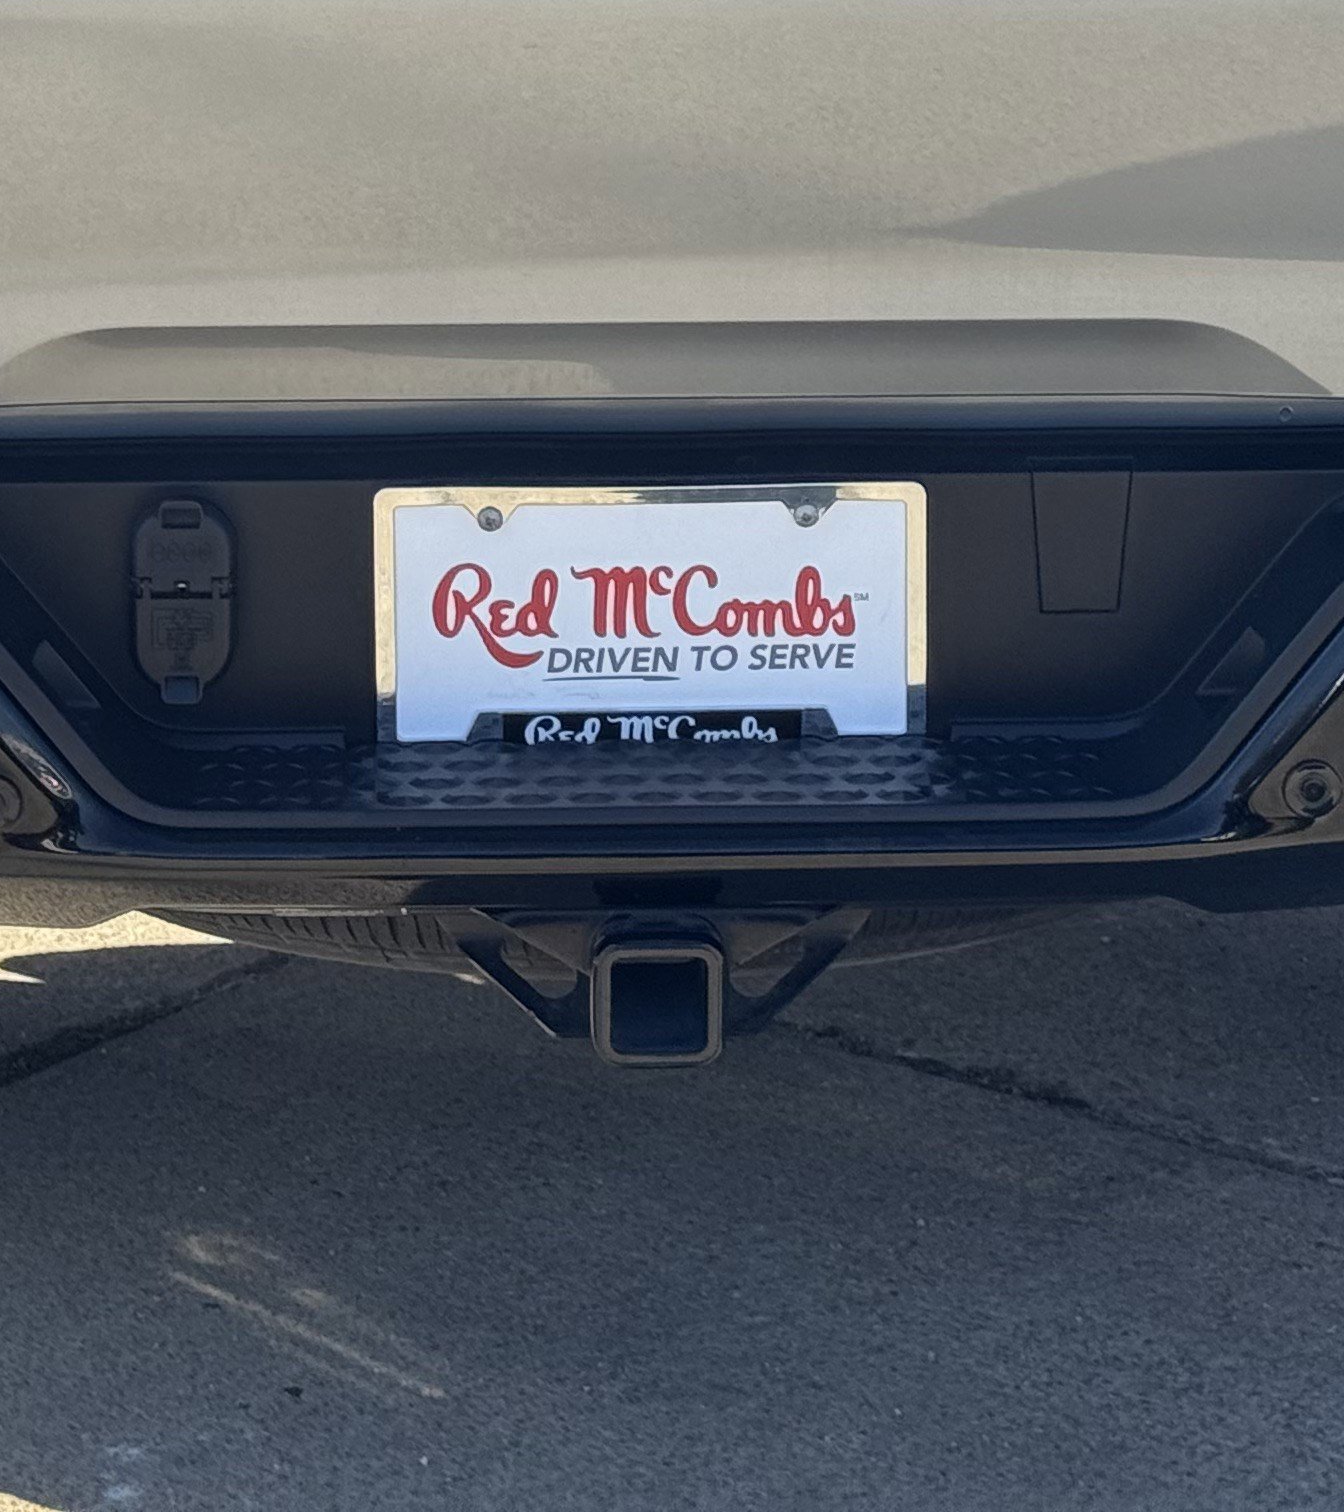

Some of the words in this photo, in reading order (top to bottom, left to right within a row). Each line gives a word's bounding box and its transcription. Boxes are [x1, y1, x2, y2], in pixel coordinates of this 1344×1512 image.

[431, 562, 560, 669] Red
[570, 564, 856, 639] McCombs
[547, 646, 680, 674] DRIVEN
[690, 644, 739, 672] TO
[747, 642, 857, 670] SERVE
